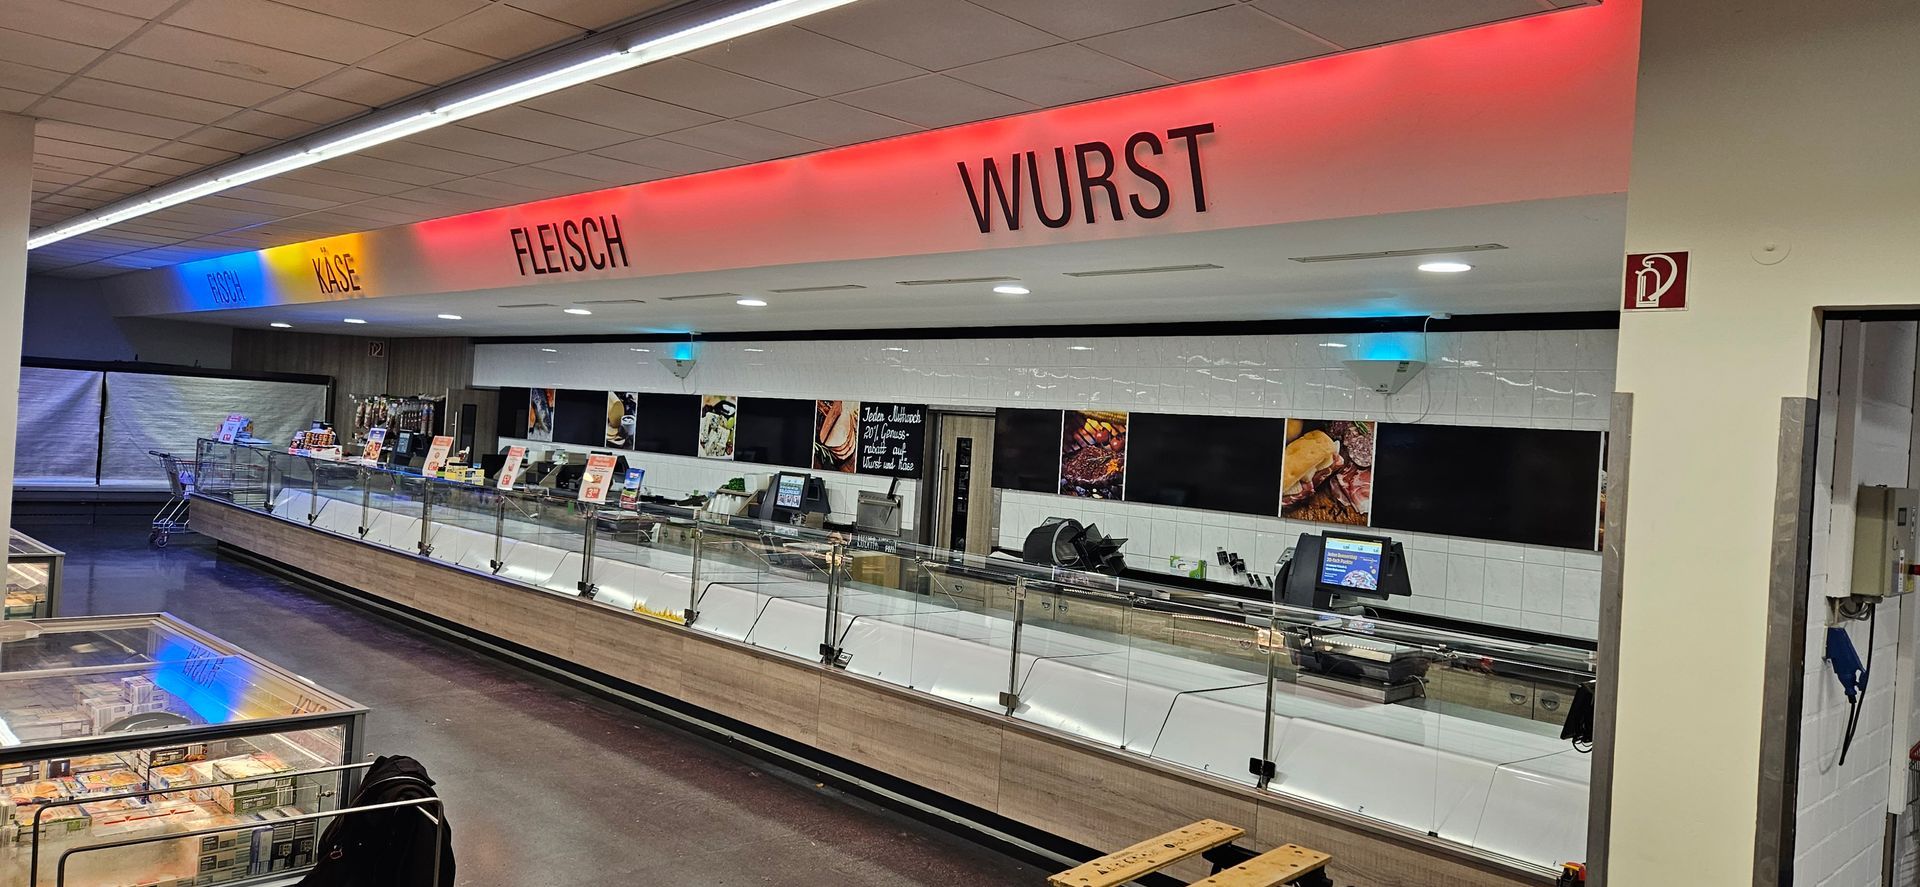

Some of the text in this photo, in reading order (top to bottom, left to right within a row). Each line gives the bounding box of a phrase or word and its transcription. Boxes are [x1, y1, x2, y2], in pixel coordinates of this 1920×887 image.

[957, 122, 1215, 233] WURST
[510, 214, 628, 276] FLEISCH
[207, 270, 246, 304] FISCH
[312, 247, 361, 294] KÄSE
[863, 405, 921, 423] Jeden Mittwoch
[863, 456, 914, 471] Wurst und Käse
[864, 442, 907, 461] rabatt auf
